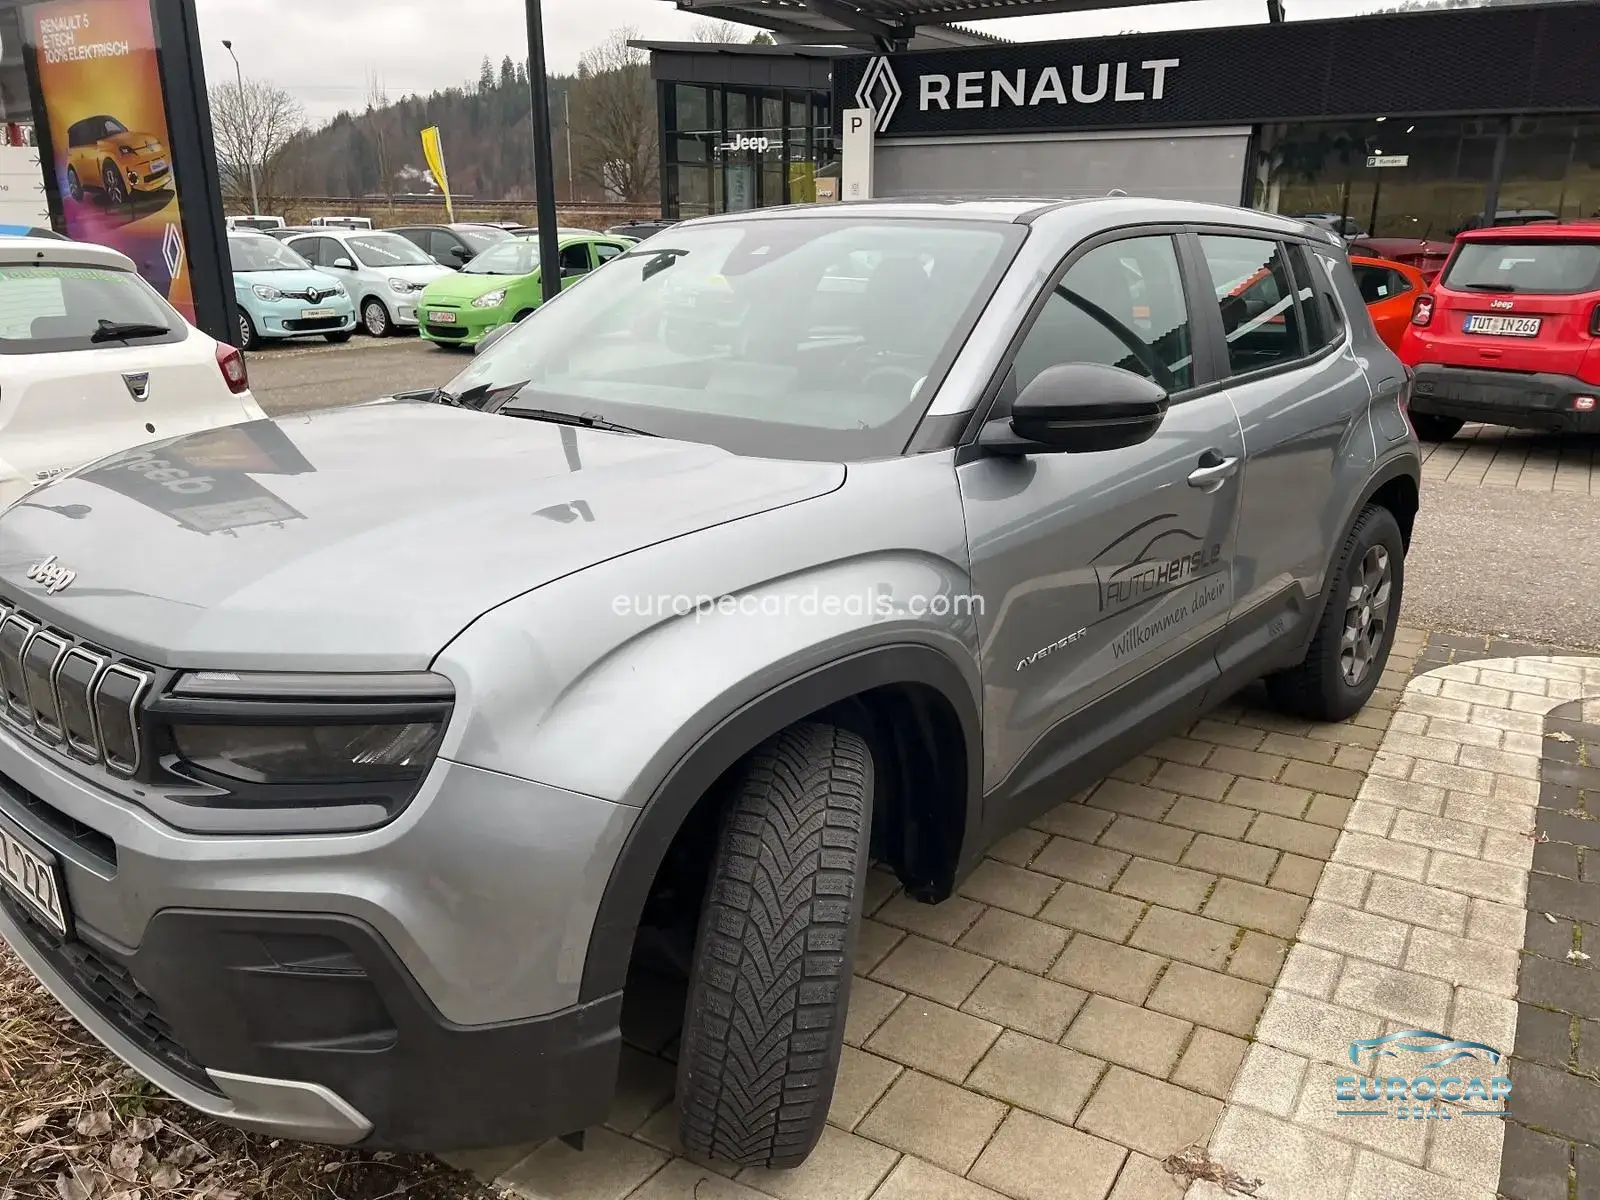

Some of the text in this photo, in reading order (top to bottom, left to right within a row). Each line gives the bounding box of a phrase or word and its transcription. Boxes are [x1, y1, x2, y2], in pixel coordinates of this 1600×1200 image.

[40, 13, 90, 33] RENAULT 5
[44, 40, 129, 64] 100% ELEKTRISCH
[919, 58, 1180, 111] RENAULT
[851, 117, 862, 133] P
[731, 133, 769, 153] Jeep
[1490, 299, 1514, 310] Jeep
[1472, 316, 1538, 333] TUT IN 266
[26, 555, 77, 596] Jeep
[1112, 606, 1188, 660] Willkommen
[1016, 627, 1087, 671] AVENGER
